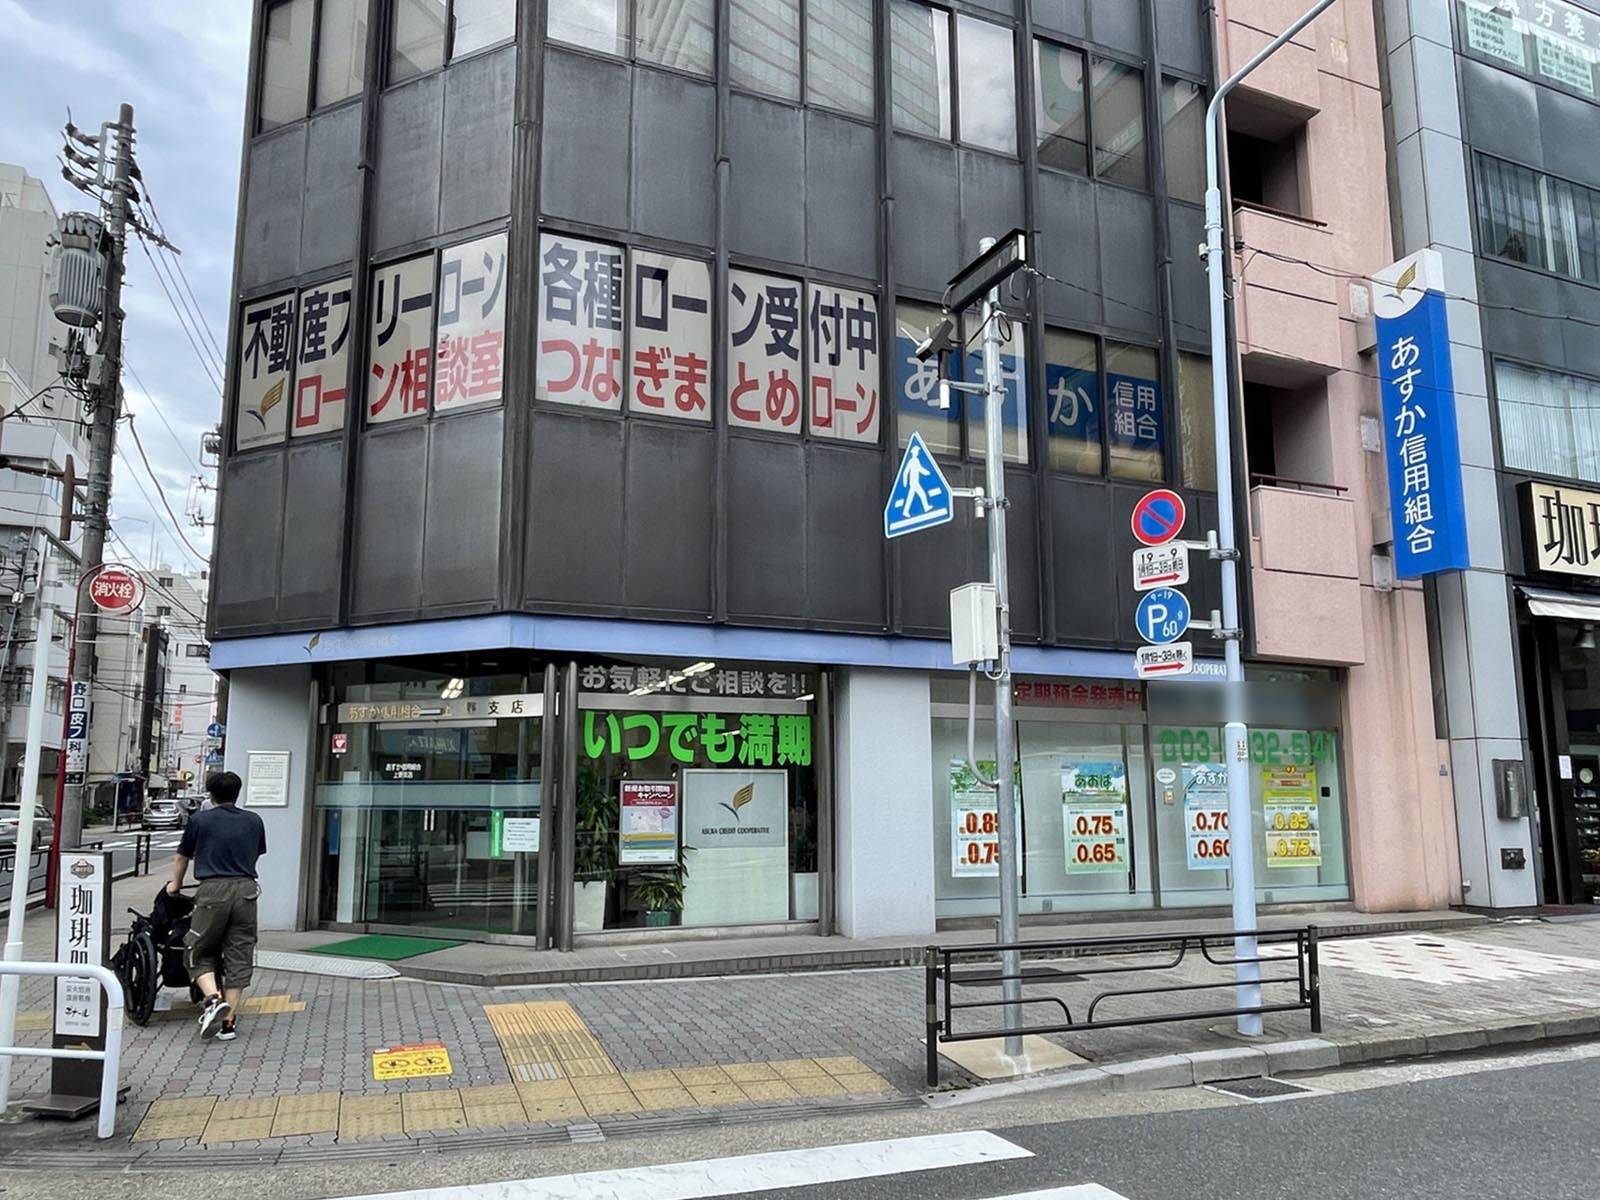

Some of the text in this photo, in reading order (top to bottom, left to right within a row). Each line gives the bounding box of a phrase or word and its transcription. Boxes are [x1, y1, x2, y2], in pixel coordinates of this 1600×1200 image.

[1112, 381, 1156, 412] 信用
[1114, 412, 1158, 440] 組合
[1390, 335, 1436, 555] あすか信用組合
[94, 581, 133, 598] 消火栓
[1148, 604, 1168, 639] P
[583, 710, 812, 766] いつでも満期
[1074, 773, 1112, 788] あおば
[965, 811, 999, 834] 0.8
